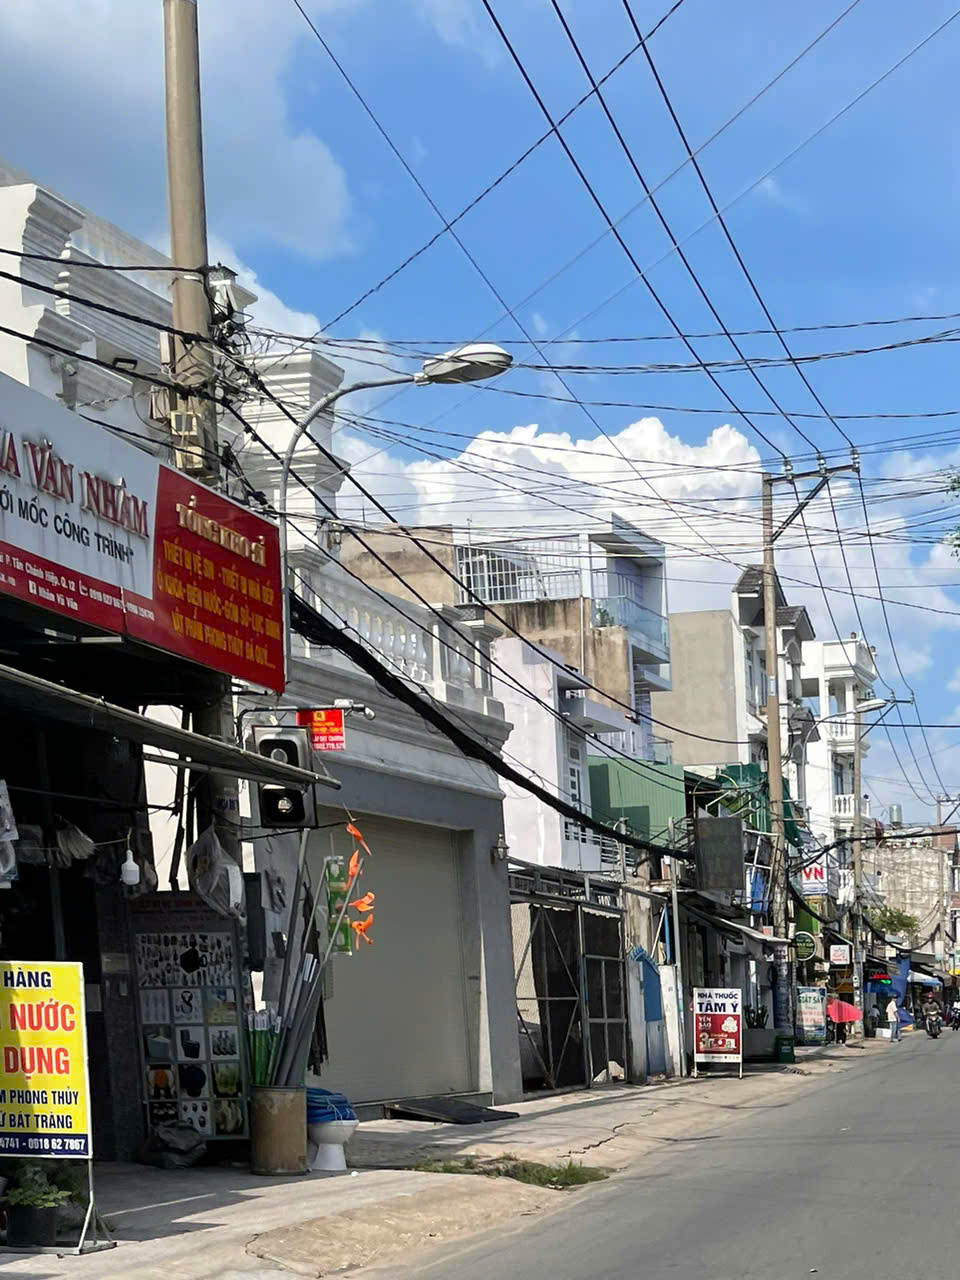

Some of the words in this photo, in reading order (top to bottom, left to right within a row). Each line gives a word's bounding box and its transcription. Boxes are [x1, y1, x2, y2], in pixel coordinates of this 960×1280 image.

[23, 438, 74, 504] VĂN
[78, 471, 149, 540] NHÂM
[18, 495, 48, 528] MỐC
[53, 512, 90, 547] CÔNG
[803, 867, 824, 880] VN
[4, 967, 52, 988] HÀNG
[697, 991, 713, 999] NHÀ
[714, 990, 738, 1000] THUỐC
[9, 998, 75, 1031] NƯỚC
[697, 1000, 726, 1013] TÂM
[731, 1000, 738, 1013] Ý
[4, 1046, 70, 1080] DỤNG
[10, 1089, 48, 1105] PHONG
[51, 1086, 79, 1105] THỦY
[34, 1111, 73, 1129] TRÀNG
[0, 1137, 20, 1149] 4741
[51, 1139, 62, 1150] 62
